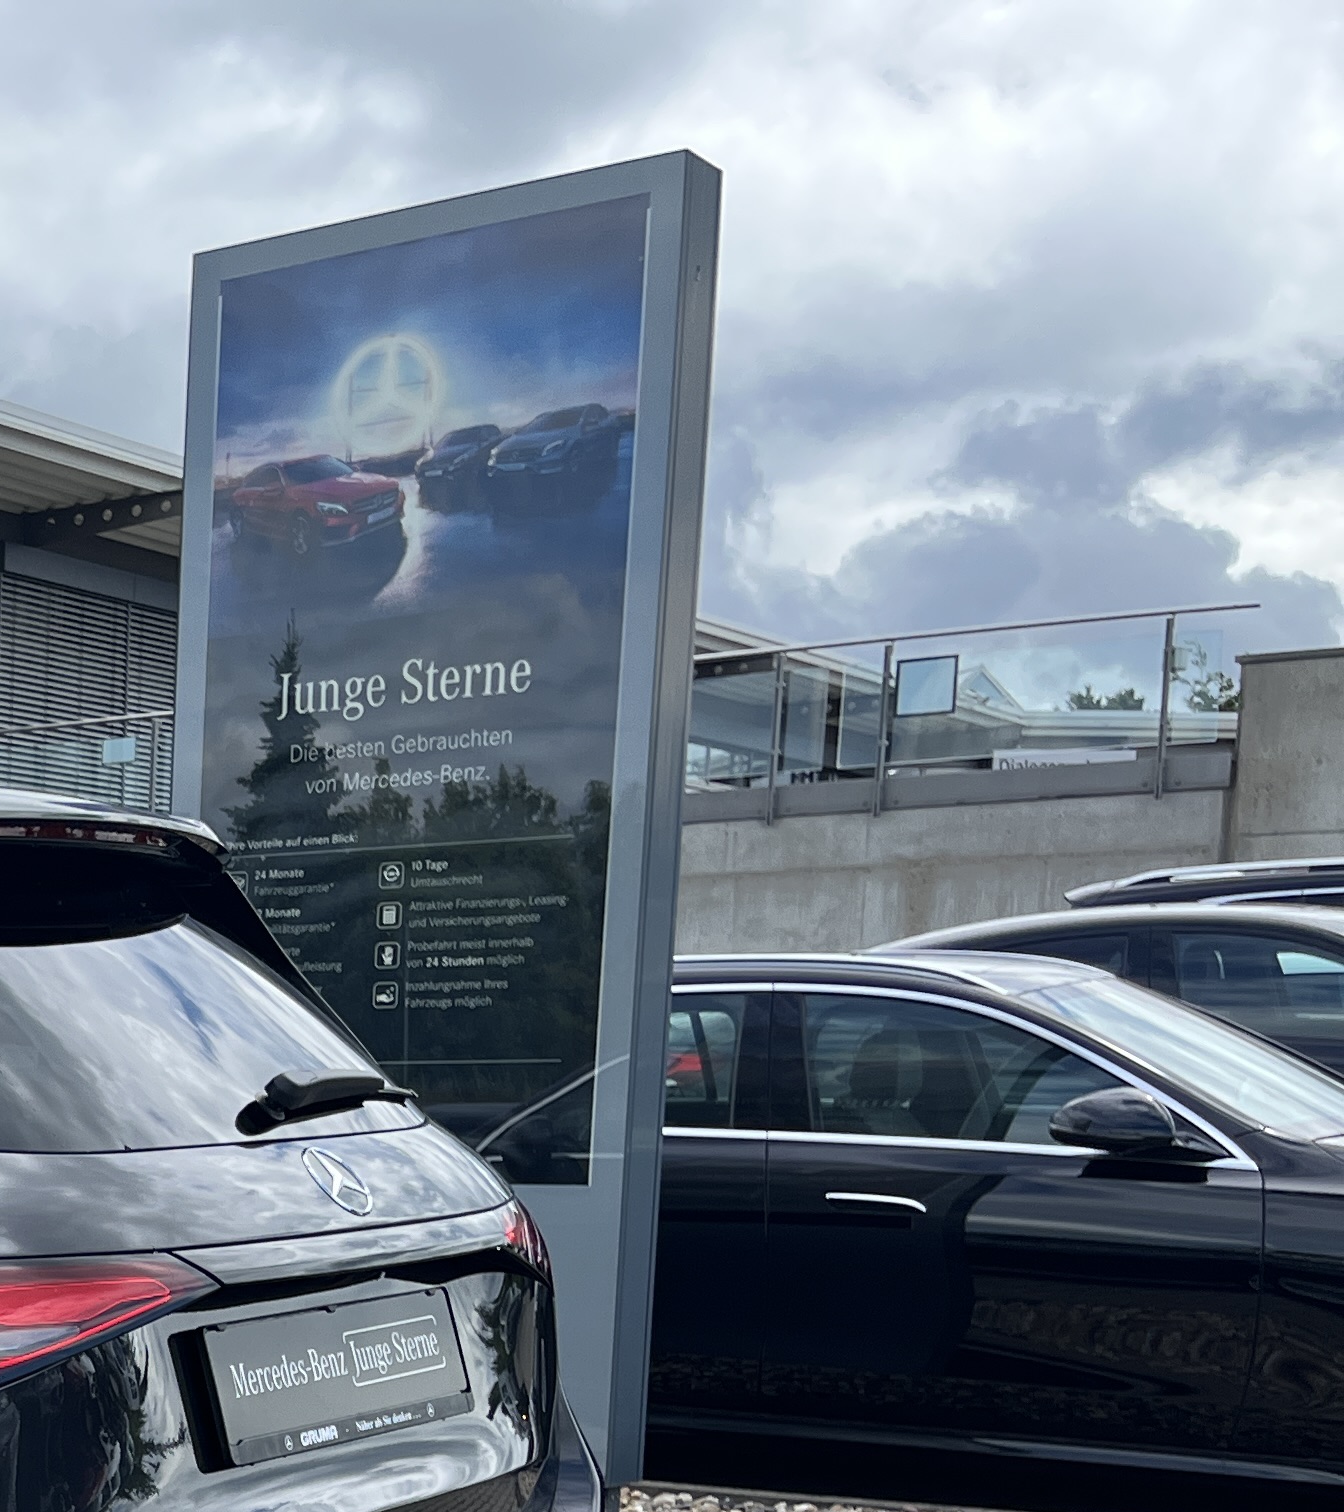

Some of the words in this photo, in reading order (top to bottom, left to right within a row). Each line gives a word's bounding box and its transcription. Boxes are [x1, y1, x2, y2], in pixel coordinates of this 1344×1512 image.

[277, 672, 386, 721] Junge
[401, 658, 532, 704] Sterne
[290, 744, 319, 764] Die
[325, 738, 385, 761] besten
[391, 729, 513, 755] Gebrauchten
[306, 777, 337, 794] von
[343, 764, 491, 791] Mercedes-Benz.
[247, 838, 284, 850] Vorteile
[285, 836, 302, 848] auf
[303, 835, 330, 847] einen
[411, 860, 423, 871] 10
[425, 859, 449, 873] Tage
[254, 869, 267, 881] 24
[268, 869, 305, 879] Monate
[265, 908, 302, 918] Monate
[408, 917, 427, 929] und
[458, 938, 486, 950] meist
[487, 936, 535, 949] innerhalb
[405, 958, 424, 969] von
[425, 956, 439, 969] 24
[441, 955, 485, 968] Stunden
[486, 954, 525, 968] möglich
[454, 995, 493, 1009] möglich
[229, 1348, 349, 1399] Mercedes-Benz
[349, 1340, 393, 1378] Junge
[391, 1331, 440, 1363] Sterne
[300, 1424, 339, 1447] GRUMA
